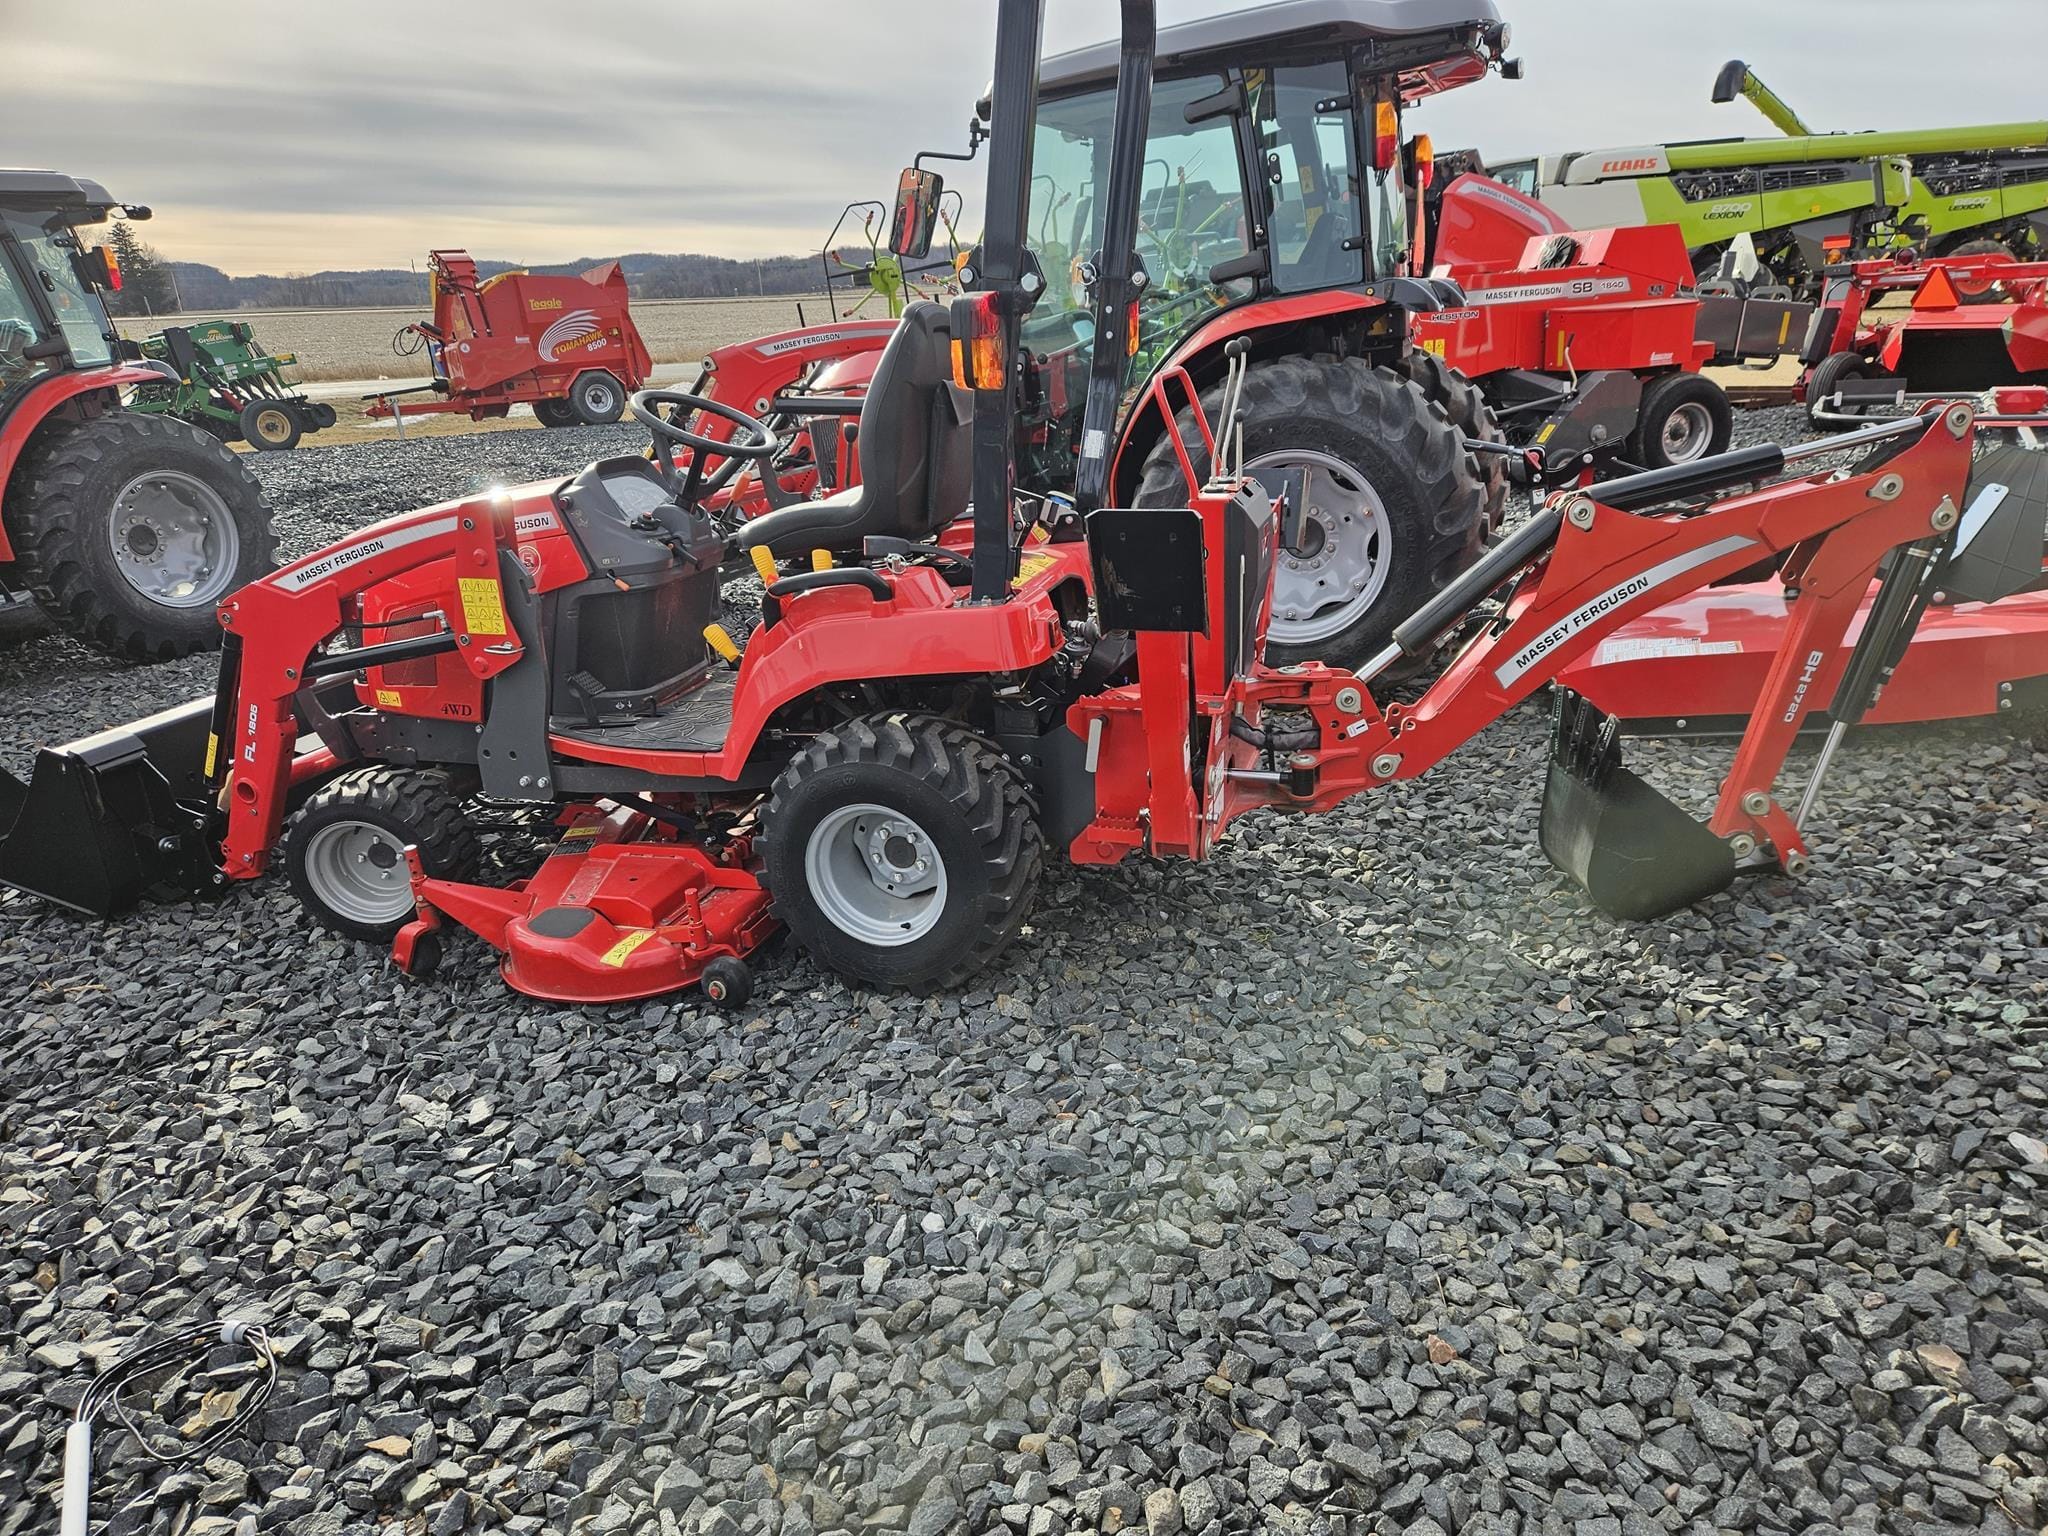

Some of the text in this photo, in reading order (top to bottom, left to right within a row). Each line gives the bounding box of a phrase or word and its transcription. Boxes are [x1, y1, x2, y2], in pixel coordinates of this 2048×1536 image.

[1602, 158, 1658, 173] CLAAS
[1703, 211, 1745, 220] LEXION
[1948, 203, 1985, 212] LEXION
[1485, 290, 1518, 301] MASSEY
[1520, 286, 1562, 298] FERGUSON
[1572, 281, 1593, 294] SB
[1431, 311, 1479, 321] HESSTON
[554, 330, 604, 355] TOMAHAWK
[587, 338, 607, 352] 8500
[773, 333, 841, 351] MASSEY FERGUSON
[296, 540, 385, 584] MASSEY FERGUSON
[1515, 623, 1571, 668] MASSEY
[1573, 576, 1649, 627] FERGUSON
[441, 703, 473, 716] 4WD
[244, 703, 258, 763] FL 1805
